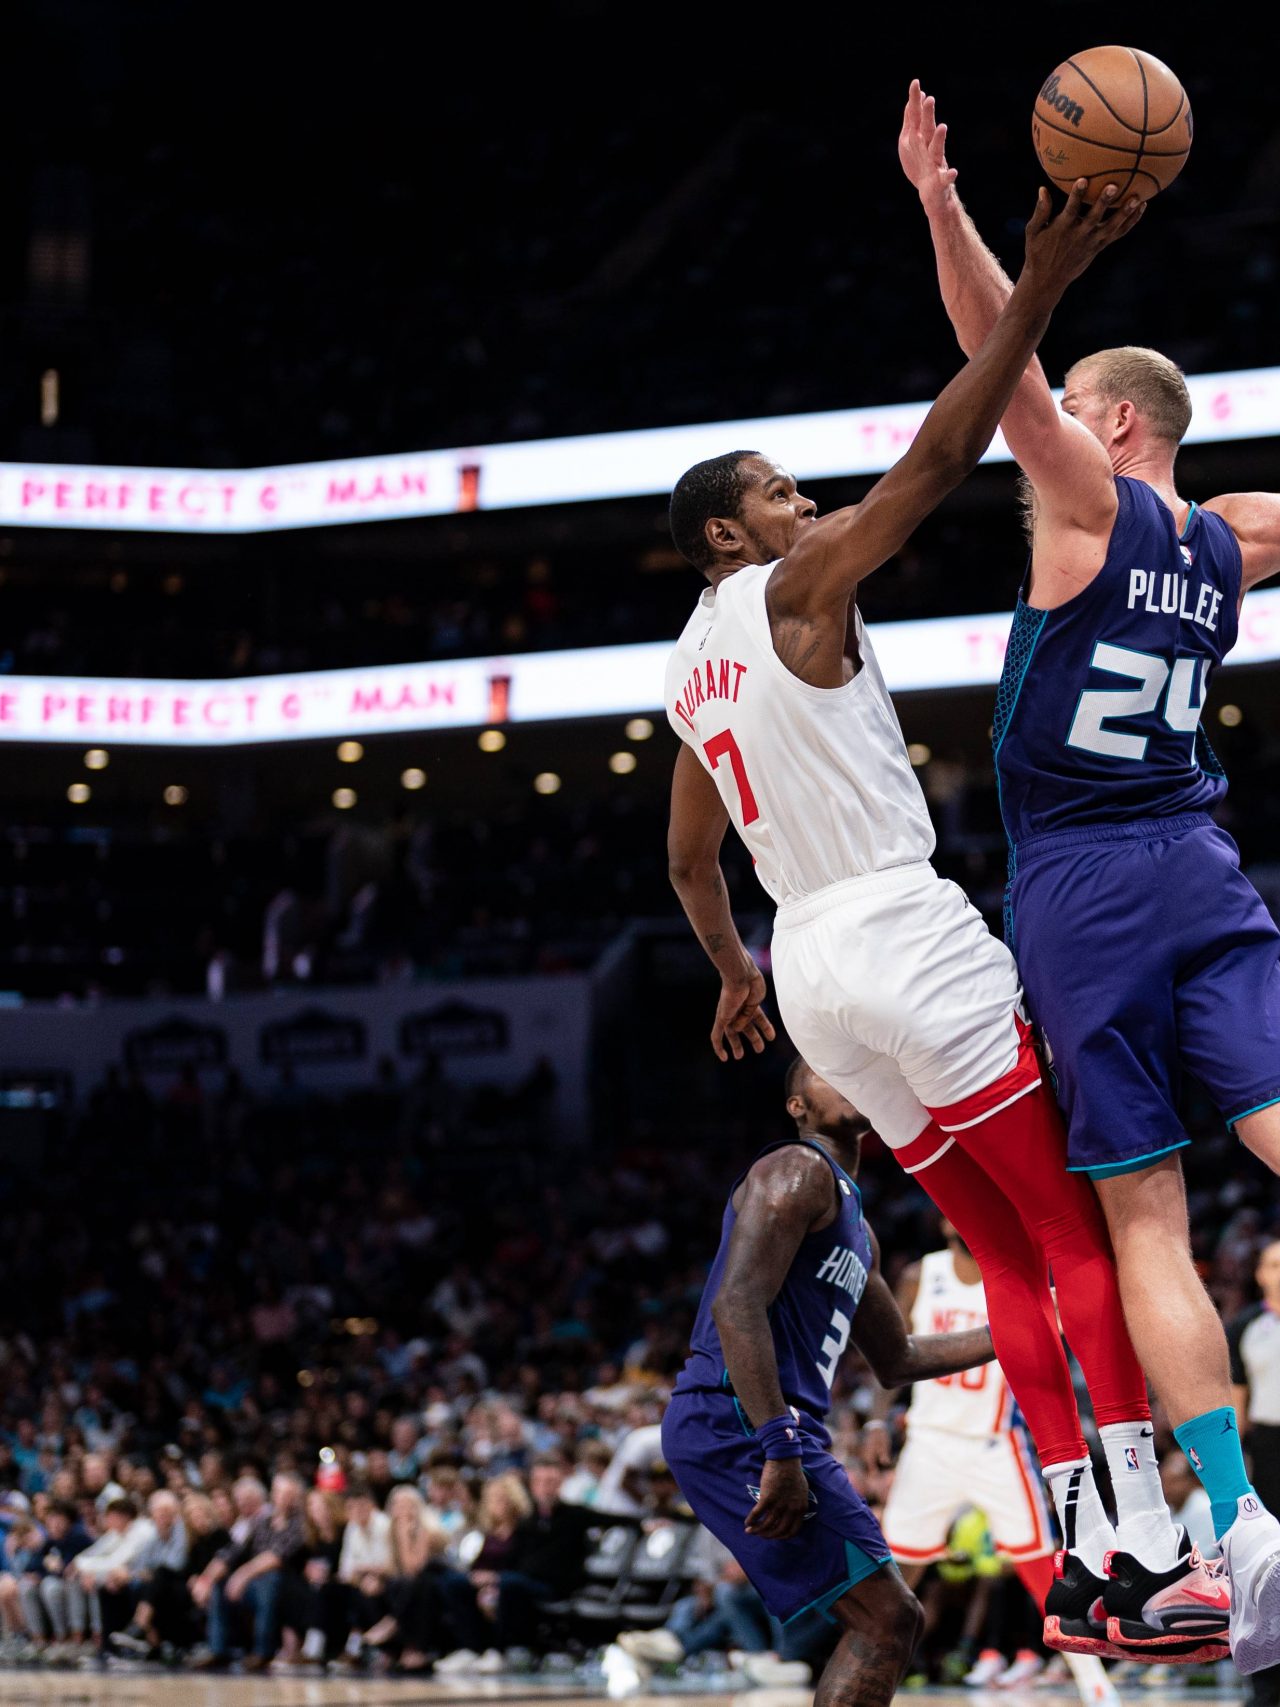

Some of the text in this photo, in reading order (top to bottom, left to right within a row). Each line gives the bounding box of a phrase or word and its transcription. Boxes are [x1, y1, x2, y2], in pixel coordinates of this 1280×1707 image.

[21, 478, 237, 516] PERFECT
[325, 473, 427, 507] MAN
[1127, 569, 1224, 632] PLULEE
[42, 692, 258, 728] PERFECT
[350, 682, 456, 715] MAN
[675, 658, 748, 733] DURANT
[1065, 640, 1206, 768] 24
[703, 728, 760, 827] 7
[816, 1308, 851, 1390] 3
